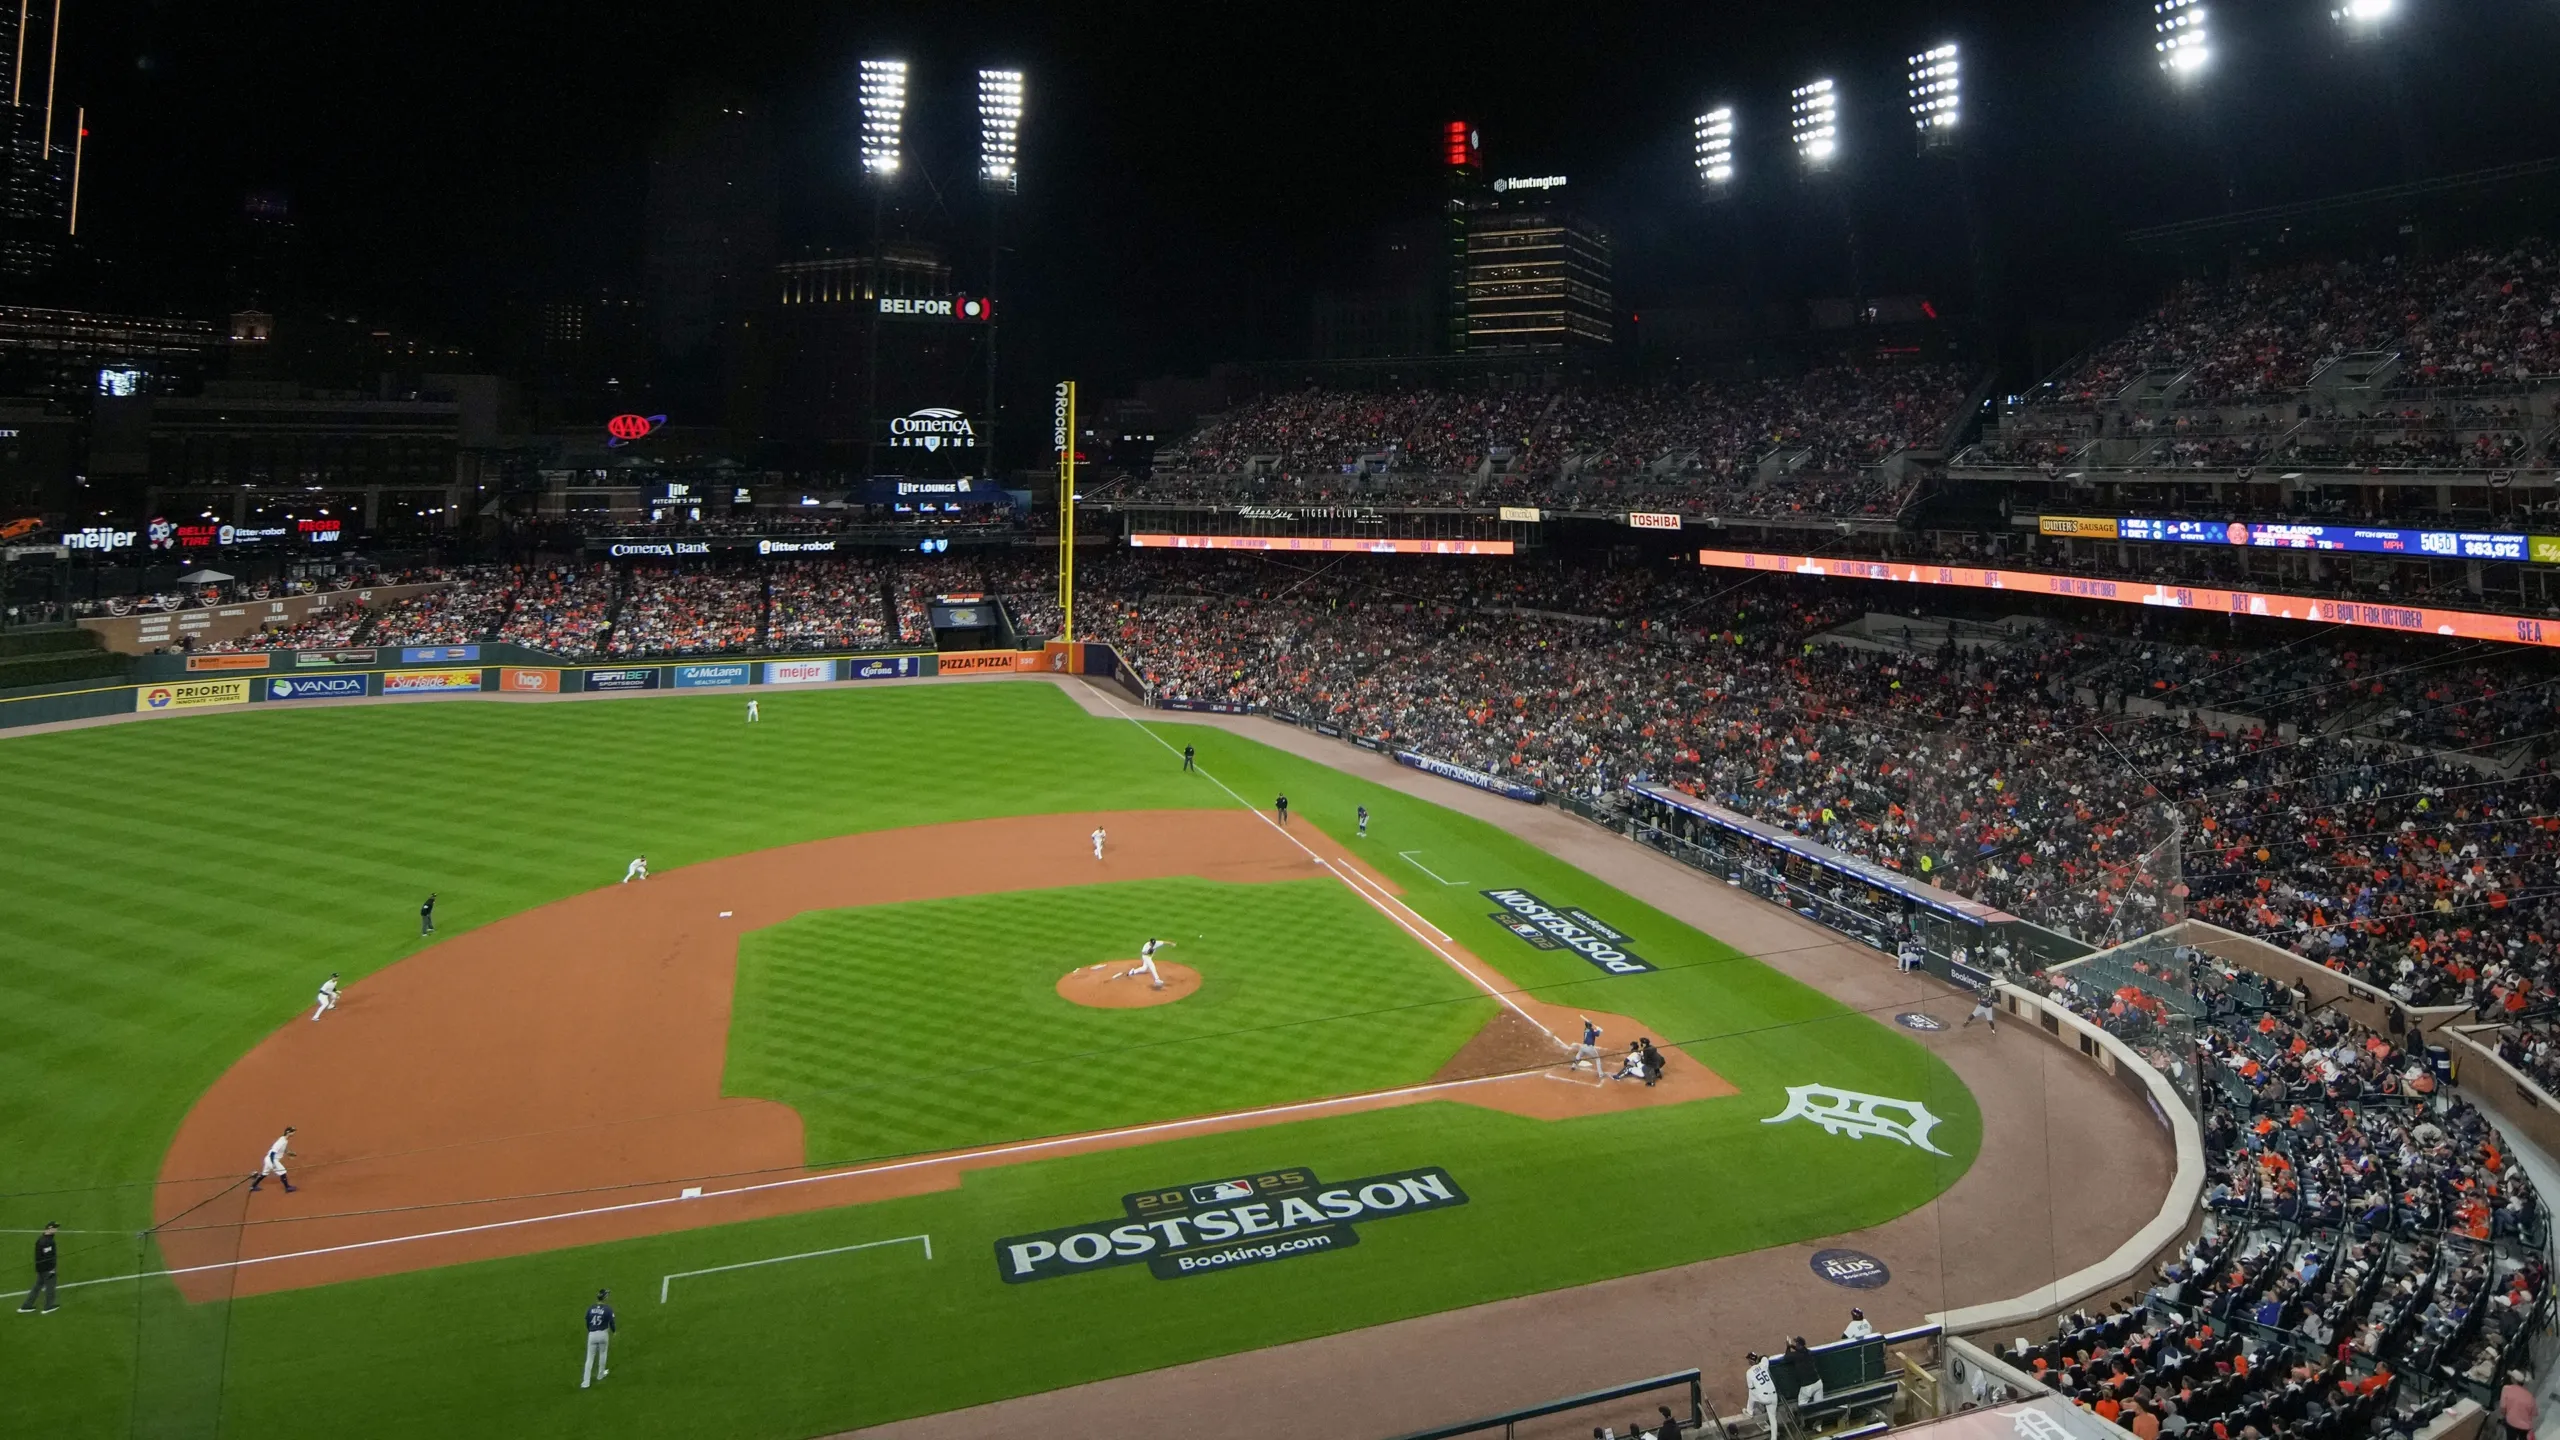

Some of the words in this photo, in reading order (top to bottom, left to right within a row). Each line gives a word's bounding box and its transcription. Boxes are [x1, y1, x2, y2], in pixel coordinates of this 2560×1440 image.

[1508, 176, 1566, 190] Huntington
[880, 298, 952, 314] BELFOR
[610, 414, 649, 439] AAA
[890, 418, 975, 435] Comerica
[1054, 398, 1068, 452] Rocket
[890, 436, 974, 448] LANDING
[668, 483, 689, 498] Lite
[898, 482, 919, 495] Lite
[920, 483, 956, 493] LOUNGE
[1236, 506, 1271, 516] Motor
[1270, 509, 1294, 520] City
[1301, 508, 1328, 518] TIGER
[1337, 508, 1358, 518] CLUB
[298, 520, 340, 532] FIEGER
[1632, 514, 1679, 528] TOSHIBA
[2042, 519, 2078, 532] WINTER'S
[2080, 523, 2114, 532] SAUSAGE
[2127, 519, 2148, 528] SEA
[2152, 520, 2162, 528] 4
[177, 526, 218, 536] BELLE
[236, 528, 286, 537] litter-robot
[312, 531, 340, 542] LAW
[2128, 530, 2148, 538] DET
[2152, 530, 2162, 539] 0
[2266, 525, 2324, 536] POLANCO
[2354, 530, 2376, 538] PITCH
[2376, 532, 2399, 540] SPEED
[62, 528, 136, 552] meijer
[181, 536, 210, 546] TIRE
[2384, 540, 2404, 550] MPH
[2460, 534, 2490, 542] CURRENT
[2491, 535, 2524, 543] JACKPOT
[611, 544, 674, 556] Comerica
[676, 542, 710, 554] Bank
[771, 540, 835, 552] litter-robot
[2464, 542, 2520, 558] $63,912
[1744, 555, 1754, 567] SEA
[1778, 557, 1788, 570] DET
[1940, 568, 1952, 584] SEA
[1984, 572, 1998, 586] DET
[360, 591, 372, 600] 42
[2060, 581, 2076, 594] BUILT
[2076, 582, 2088, 595] FOR
[2089, 582, 2116, 598] OCTOBER
[2176, 588, 2194, 606] SEA
[2232, 592, 2248, 612] DET
[271, 602, 284, 613] 10
[2336, 604, 2360, 622] BUILT
[2363, 605, 2380, 624] FOR
[2382, 606, 2423, 628] OCTOBER
[2517, 620, 2542, 642] SEA
[940, 658, 975, 670] PIZZA!
[978, 656, 1012, 668] PIZZA!
[592, 672, 626, 681] ESPN
[626, 670, 652, 680] BET
[700, 667, 742, 677] McLaren
[779, 664, 820, 680] meijer
[860, 666, 893, 678] Corona
[294, 680, 360, 692] VANDA
[392, 675, 445, 689] Surfside
[176, 684, 240, 698] PRIORITY
[1430, 760, 1488, 788] POSTSEASON
[1488, 890, 1647, 973] POSTSEASON
[1570, 910, 1622, 940] Booking.com
[1951, 968, 1986, 990] Booking.c
[1136, 1190, 1184, 1209] 20
[1257, 1171, 1305, 1189] 25
[1008, 1174, 1455, 1275] POSTSEASON
[1178, 1233, 1332, 1271] Booking.com
[1826, 1260, 1874, 1277] ALDS
[590, 1315, 602, 1326] 45
[1756, 1370, 1770, 1386] 56
